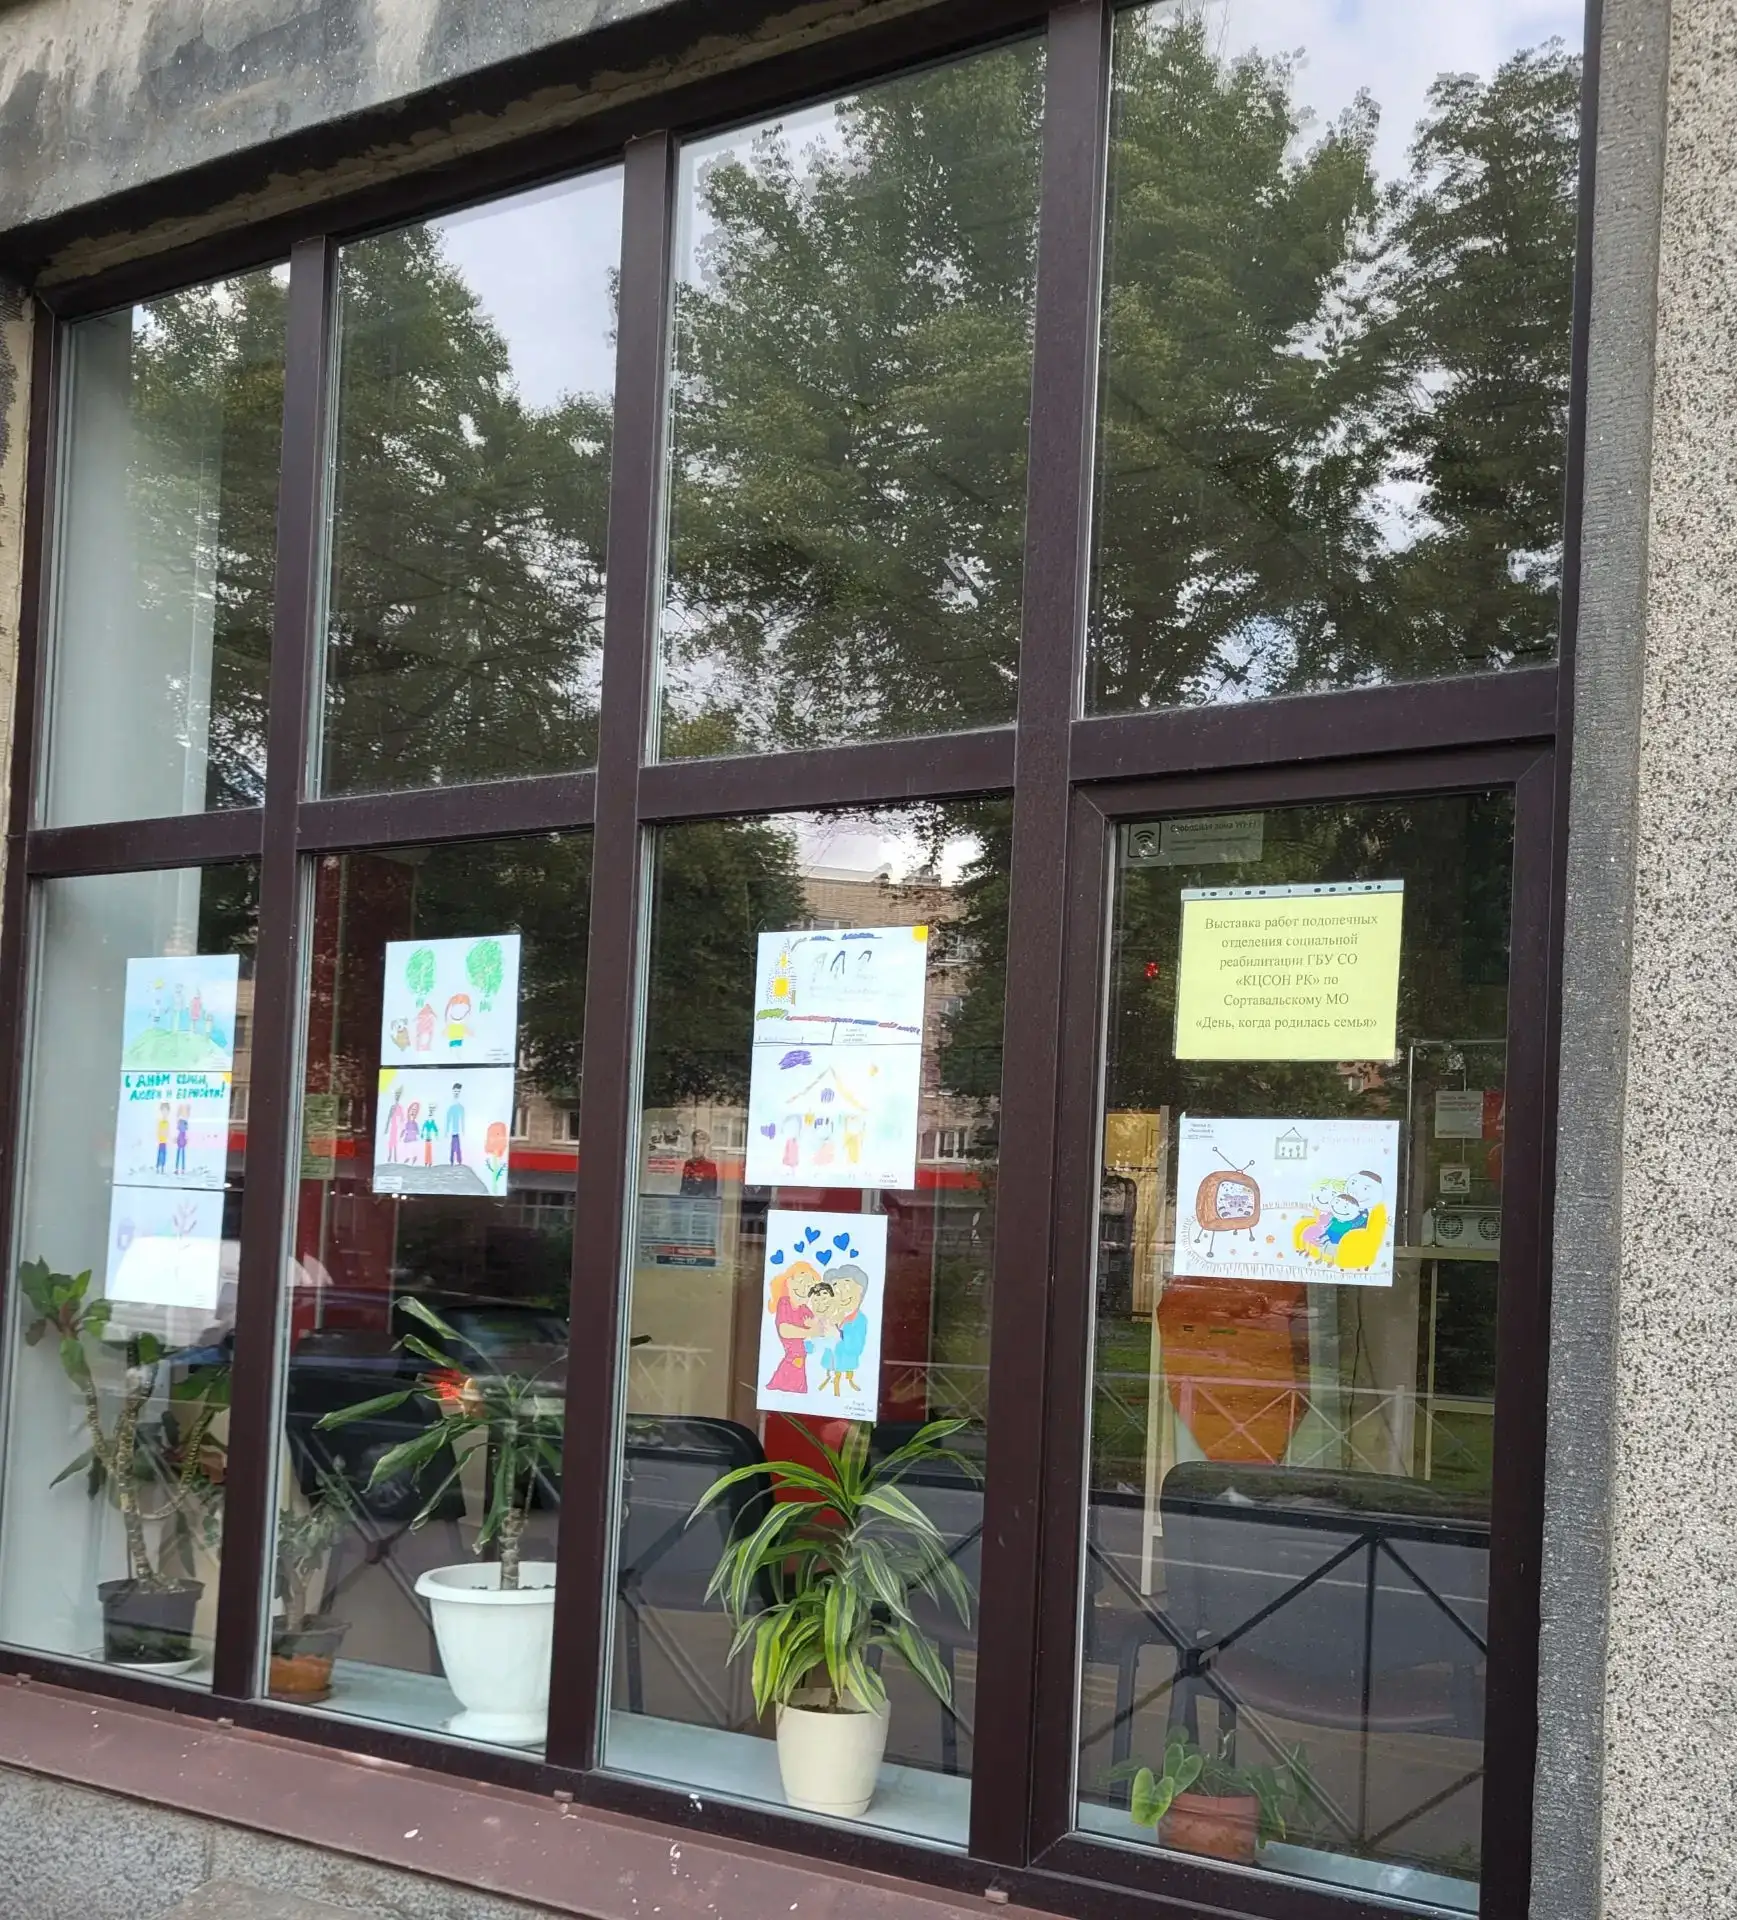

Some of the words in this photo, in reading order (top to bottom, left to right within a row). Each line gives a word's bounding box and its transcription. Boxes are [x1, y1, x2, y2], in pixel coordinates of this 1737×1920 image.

[1205, 917, 1261, 930] Выставка
[1264, 916, 1299, 930] работ
[1302, 915, 1378, 927] подопечных
[1221, 936, 1283, 949] отделения
[1285, 933, 1359, 946] социальной
[1219, 956, 1304, 970] реабилитации
[1307, 954, 1335, 966] ГБУ
[1337, 953, 1359, 965] СО
[1235, 974, 1292, 988] «КЦСОН
[1295, 974, 1320, 986] РК»
[1323, 976, 1340, 985] по
[1223, 994, 1322, 1009] Сортавальскому
[1325, 993, 1350, 1005] МО
[1195, 1016, 1236, 1030] «День,
[1238, 1019, 1272, 1030] когда
[1274, 1018, 1331, 1031] родилась
[1333, 1018, 1378, 1028] семья»
